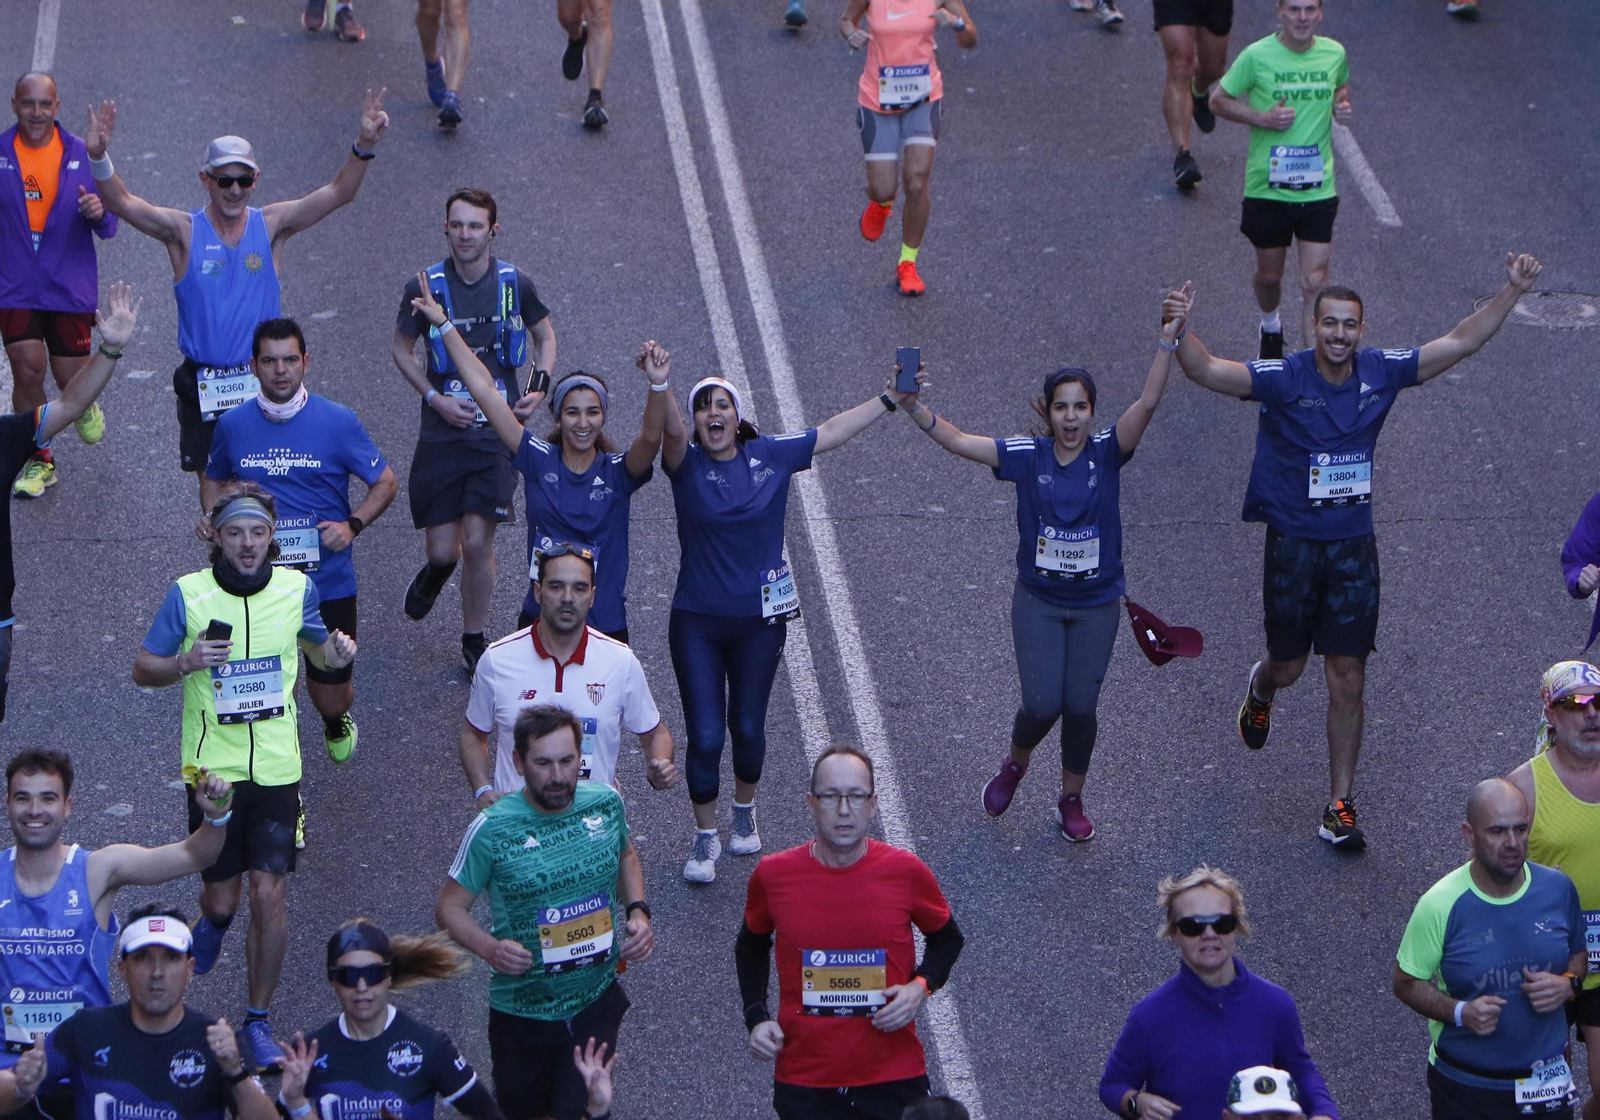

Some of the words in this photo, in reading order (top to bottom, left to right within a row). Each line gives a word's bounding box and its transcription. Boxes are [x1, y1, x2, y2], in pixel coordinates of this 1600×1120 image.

[895, 68, 924, 76] ZURICH
[1274, 71, 1329, 83] NEVER
[894, 84, 919, 92] 11174
[1272, 90, 1312, 101] GIVE
[1314, 88, 1332, 100] UP
[1288, 146, 1318, 155] ZURICH
[217, 364, 251, 378] ZURICH
[215, 382, 244, 394] 12360
[240, 458, 274, 469] Chicago
[276, 457, 321, 468] Marathon
[1332, 452, 1366, 464] ZURICH
[268, 466, 290, 476] 2017
[1328, 471, 1356, 482] 13804
[1329, 486, 1353, 496] HAMZA
[275, 518, 310, 528] ZURICH
[1058, 530, 1093, 540] ZURICH
[1054, 550, 1085, 559] 11292
[234, 660, 274, 673] ZURICH
[232, 681, 266, 694] 12580
[237, 700, 264, 710] JULIEN
[500, 834, 528, 850] ONE
[538, 821, 568, 838] 56KM
[510, 846, 540, 858] 56KM
[540, 834, 566, 850] RUN
[567, 827, 583, 840] AS
[510, 878, 537, 892] ONE
[550, 863, 580, 880] 56KM
[583, 850, 610, 868] 56KM
[550, 876, 576, 892] RUN
[579, 869, 595, 882] AS
[596, 858, 616, 874] ONE
[562, 898, 602, 918] ZURICH
[566, 925, 595, 942] 5503
[570, 942, 596, 956] CHRIS
[829, 954, 876, 964] ZURICH
[830, 978, 860, 989] 5565
[28, 990, 73, 1001] ZURICH
[820, 994, 869, 1003] MORRISON
[24, 1012, 62, 1024] 11810
[1522, 1087, 1556, 1100] MARCOS
[344, 1096, 402, 1110] indurco
[119, 1100, 178, 1120] indurco
